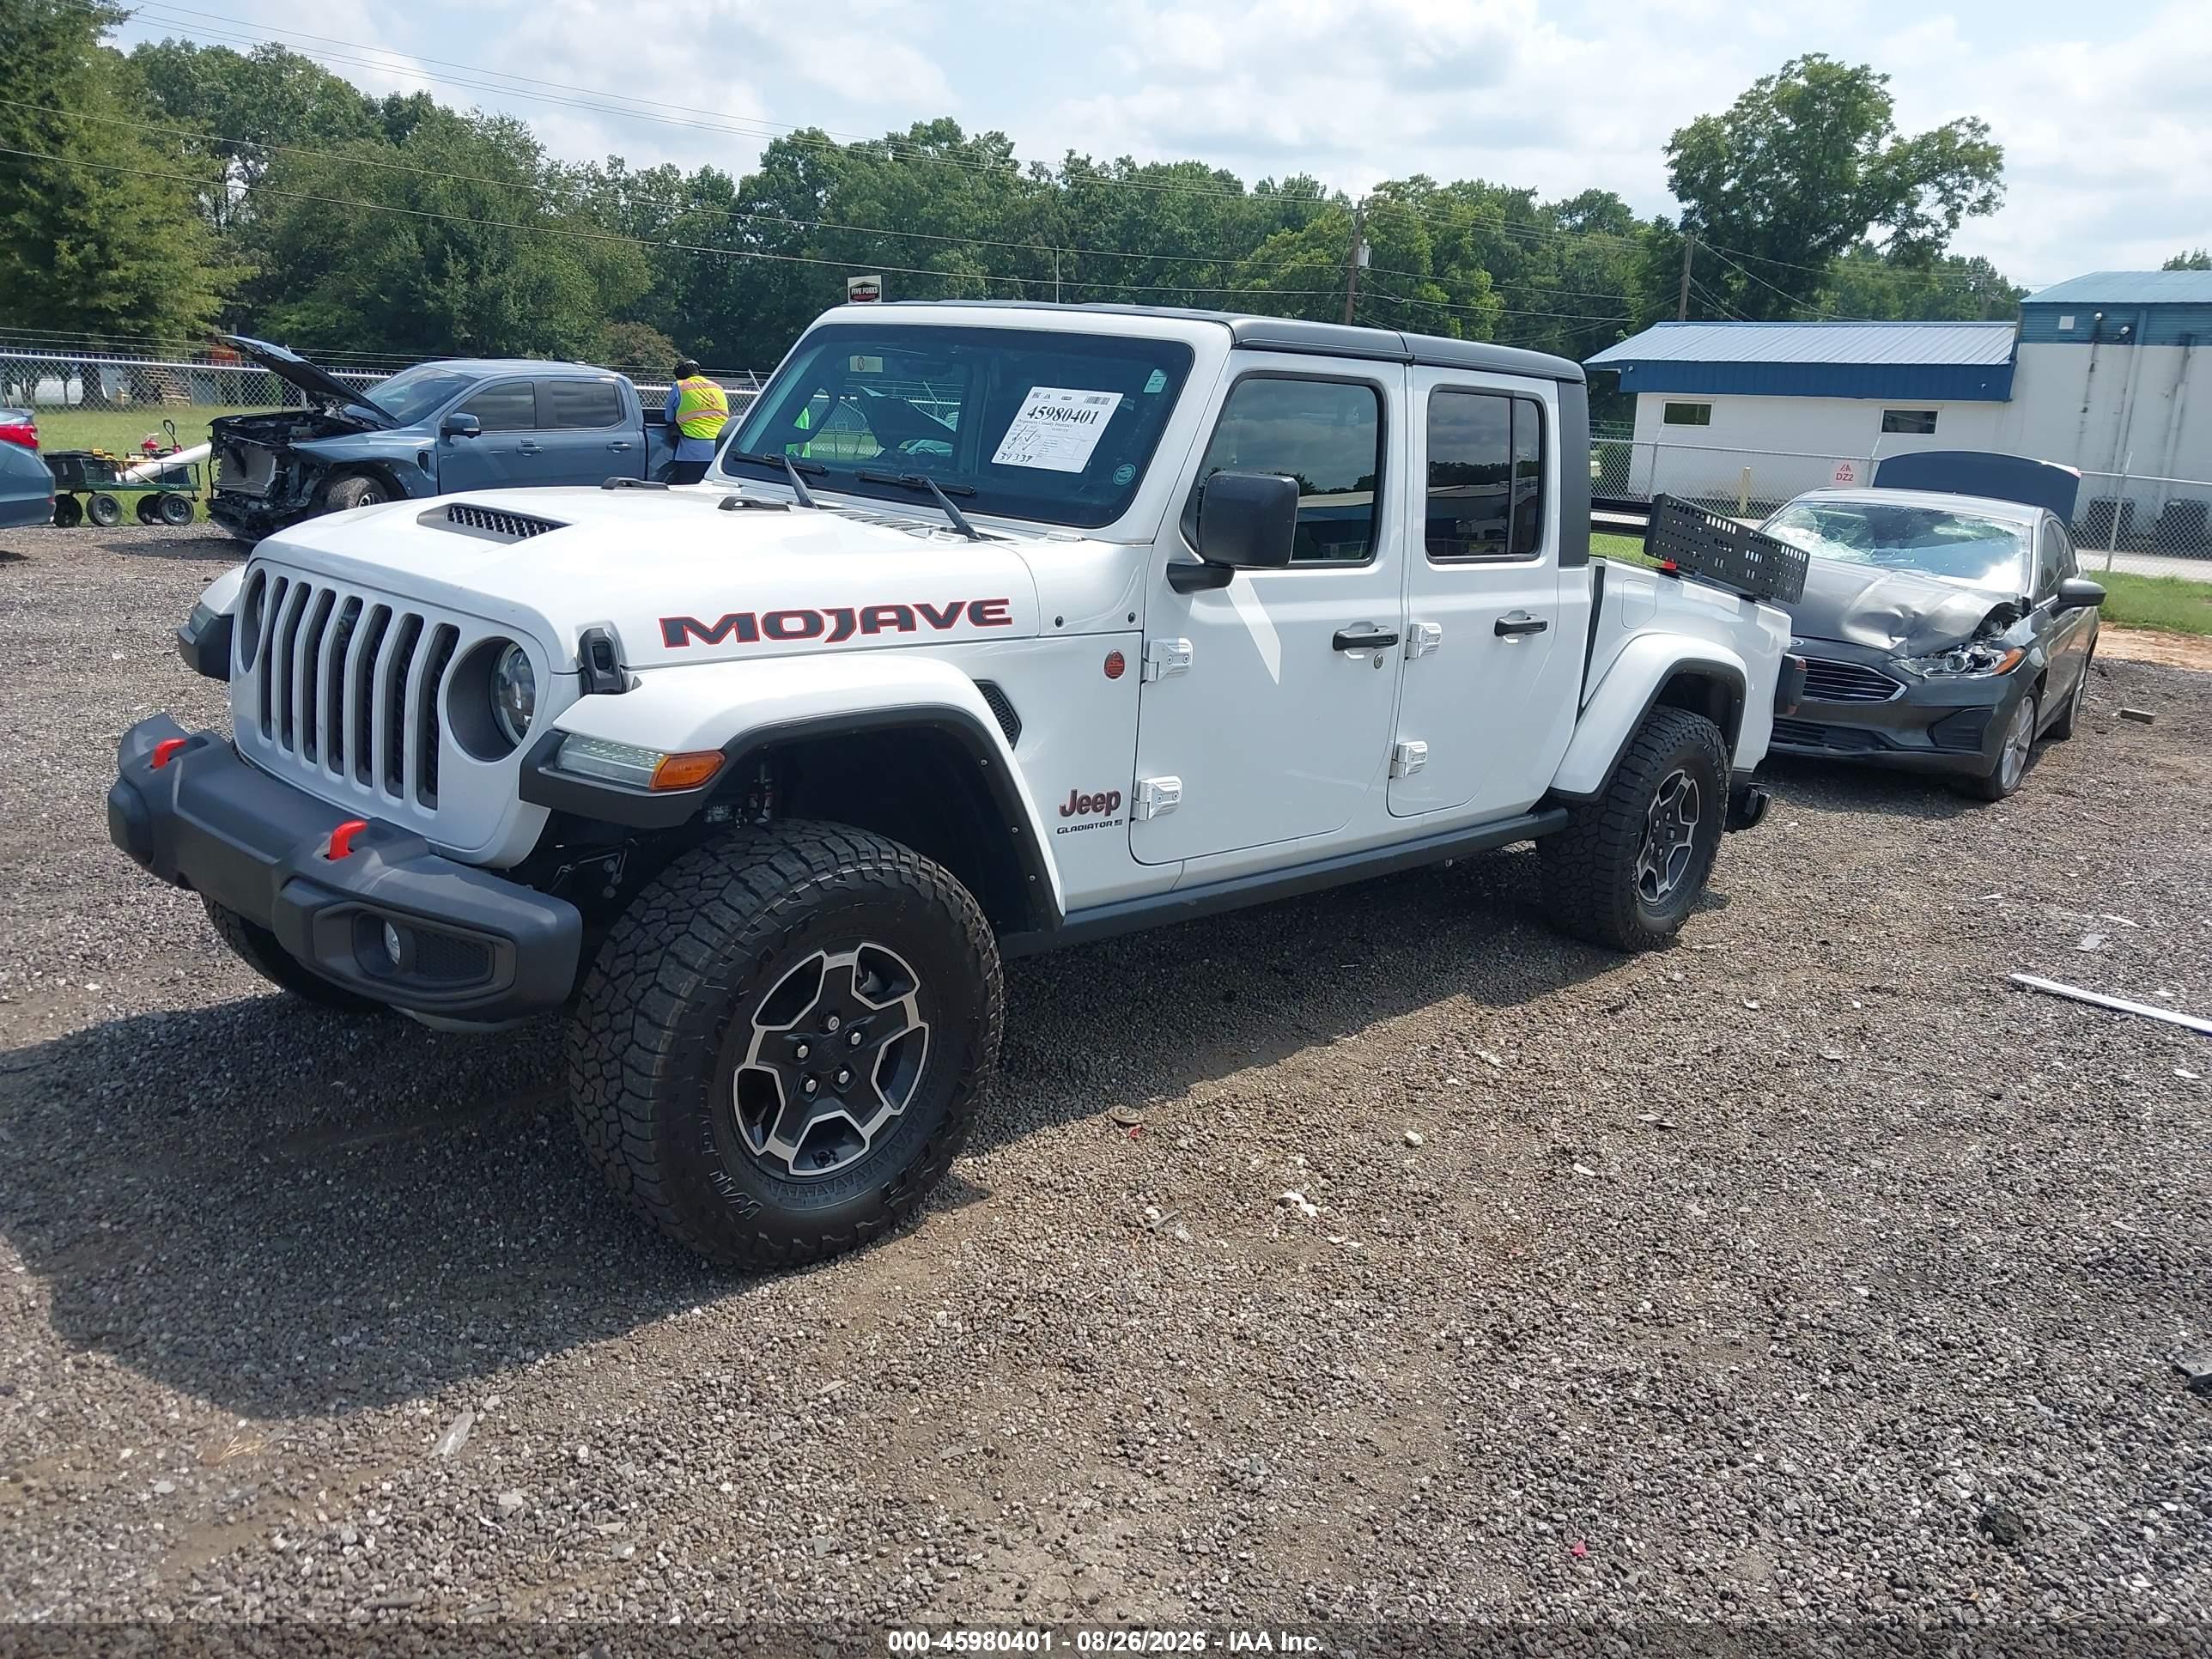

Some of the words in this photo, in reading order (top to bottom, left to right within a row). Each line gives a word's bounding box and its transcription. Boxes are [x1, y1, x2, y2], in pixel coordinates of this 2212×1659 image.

[1026, 404, 1100, 426] 45980401
[1836, 472, 1854, 482] DZ2
[659, 598, 1013, 648] MOJAVE
[1059, 788, 1121, 817] Jeep
[1056, 820, 1113, 835] GLADIATOR
